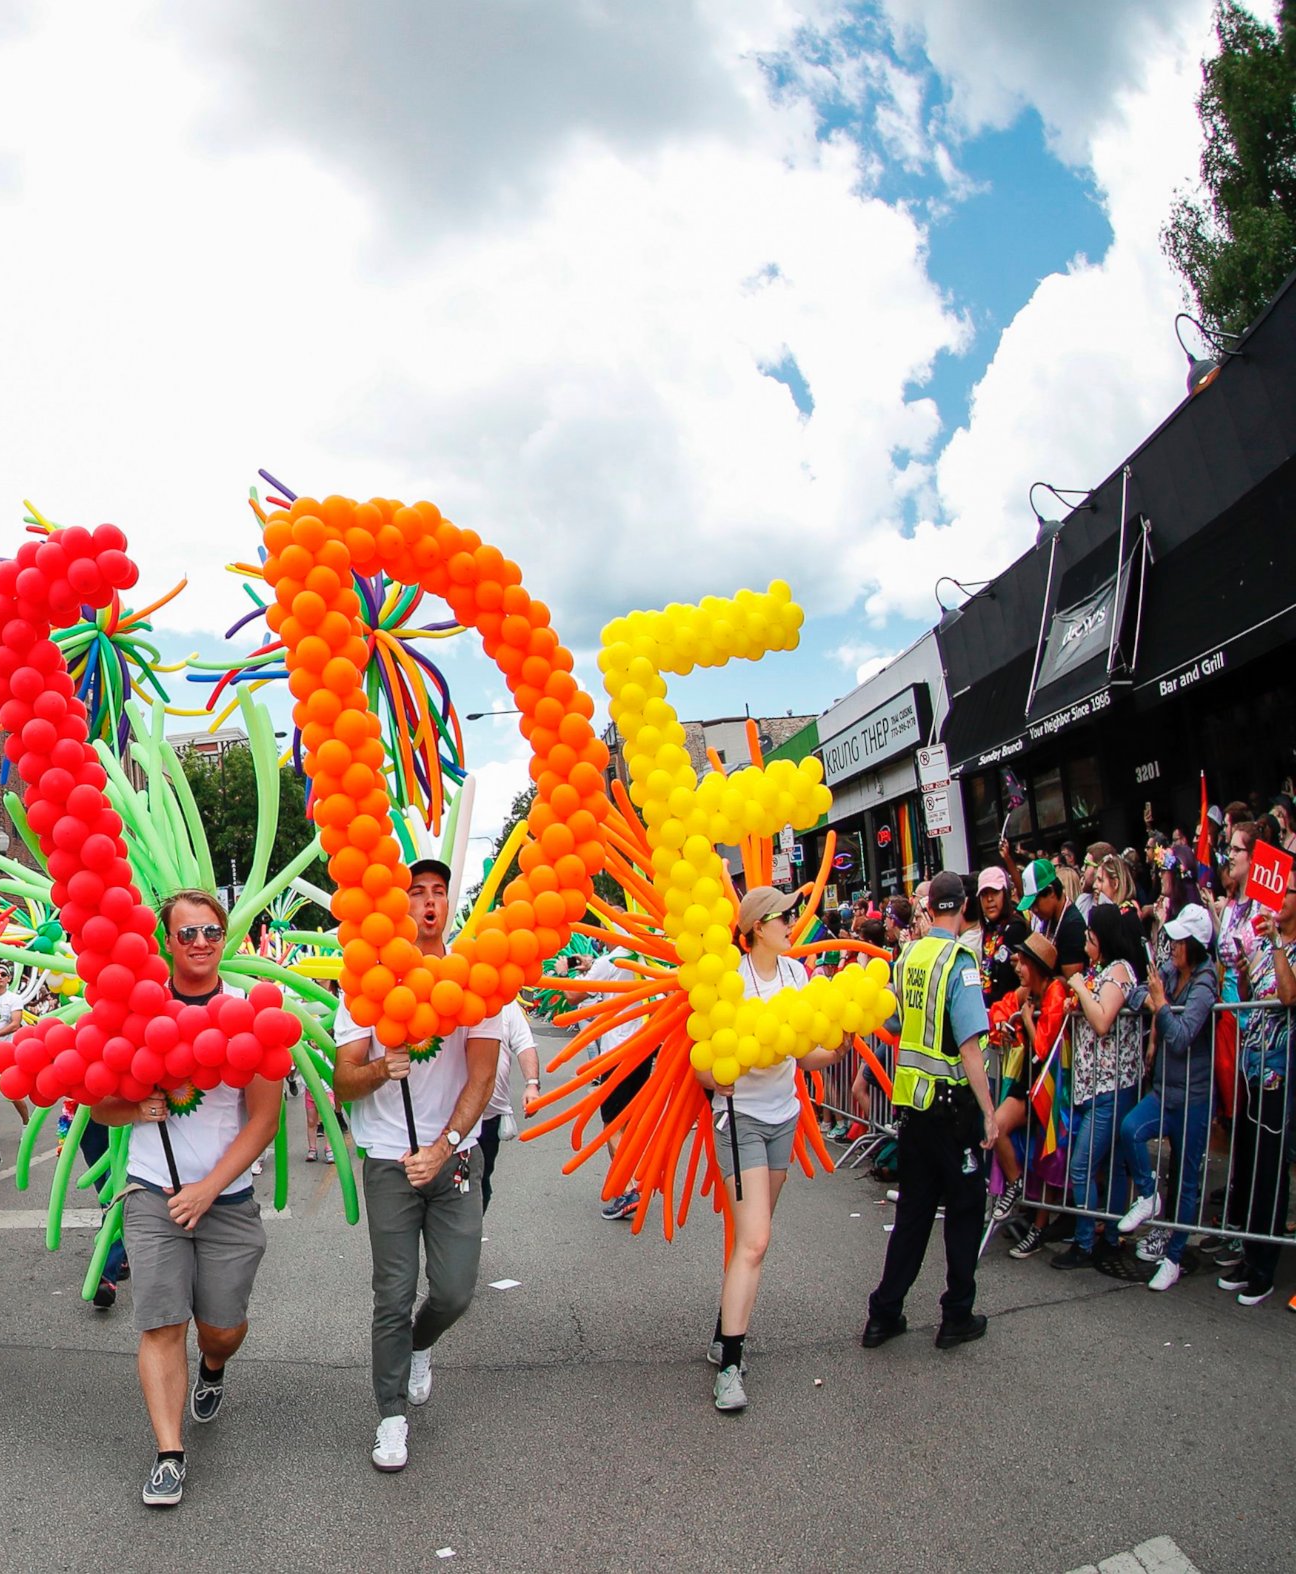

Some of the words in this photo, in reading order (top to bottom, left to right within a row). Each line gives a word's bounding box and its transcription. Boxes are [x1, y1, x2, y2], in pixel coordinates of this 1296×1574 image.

[1159, 680, 1177, 696] Bar
[1179, 664, 1200, 688] and
[1201, 651, 1225, 675] Grill
[1029, 727, 1044, 740] Your
[1043, 713, 1071, 733] Neighbor
[1070, 703, 1090, 721] Since
[1090, 691, 1111, 712] 1996
[825, 736, 860, 776] KRUNG
[861, 717, 890, 756] THEP
[978, 748, 1001, 766] Sunday
[1002, 739, 1023, 757] Brunch
[1135, 760, 1160, 783] 3201
[1252, 860, 1284, 894] mb
